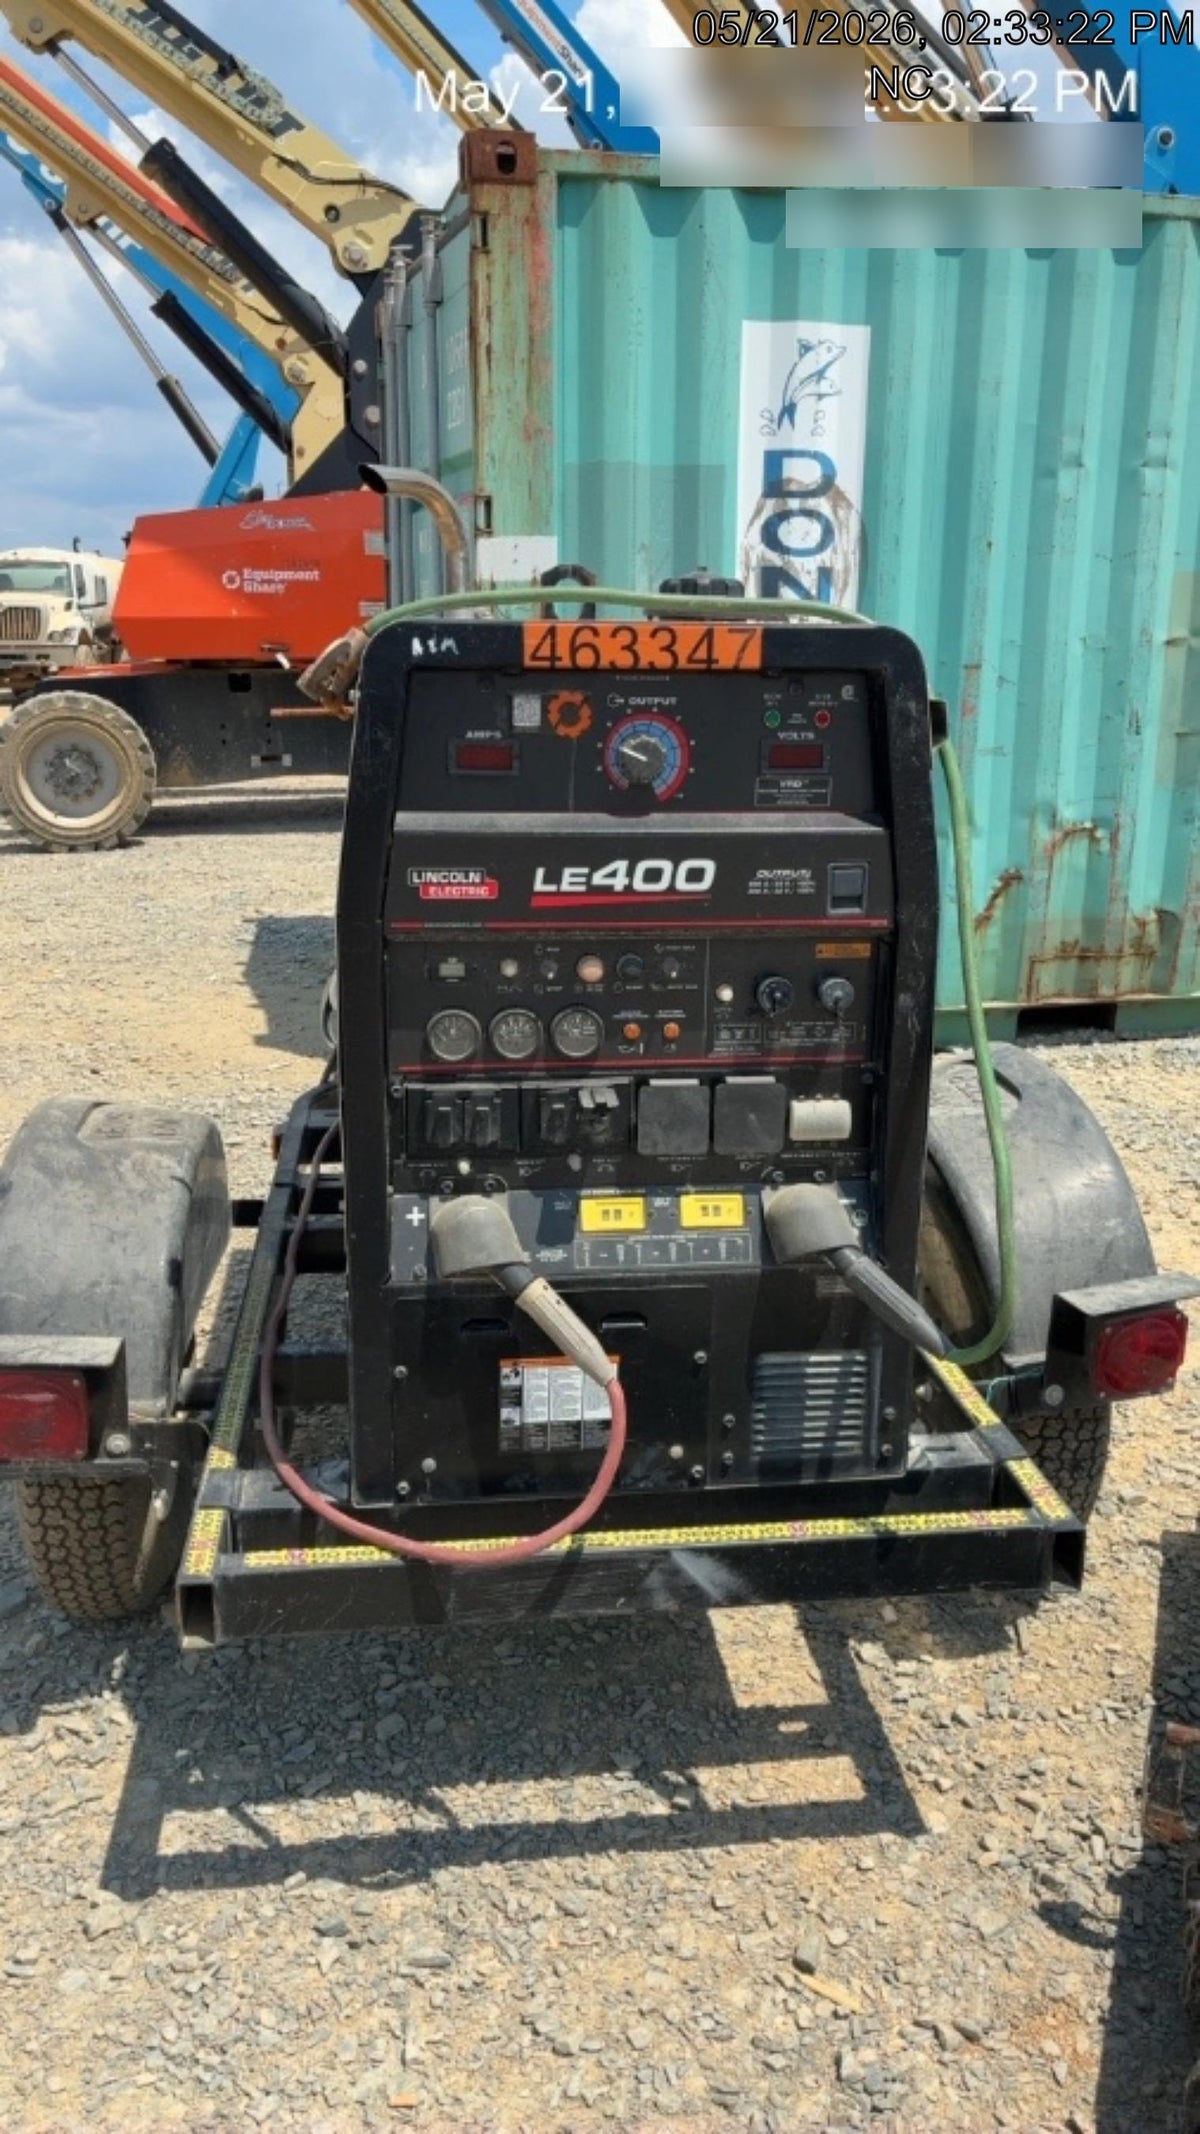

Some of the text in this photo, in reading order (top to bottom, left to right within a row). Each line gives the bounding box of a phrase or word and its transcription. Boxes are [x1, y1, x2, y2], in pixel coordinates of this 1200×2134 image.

[243, 568, 320, 582] Equipment
[243, 581, 286, 594] Share
[528, 624, 758, 671] 463347
[627, 696, 678, 706] OUTPUT
[777, 731, 815, 741] VOLTS
[412, 871, 482, 883] LINCOLN
[532, 858, 717, 893] LE400
[428, 885, 490, 897] ELECTRIC
